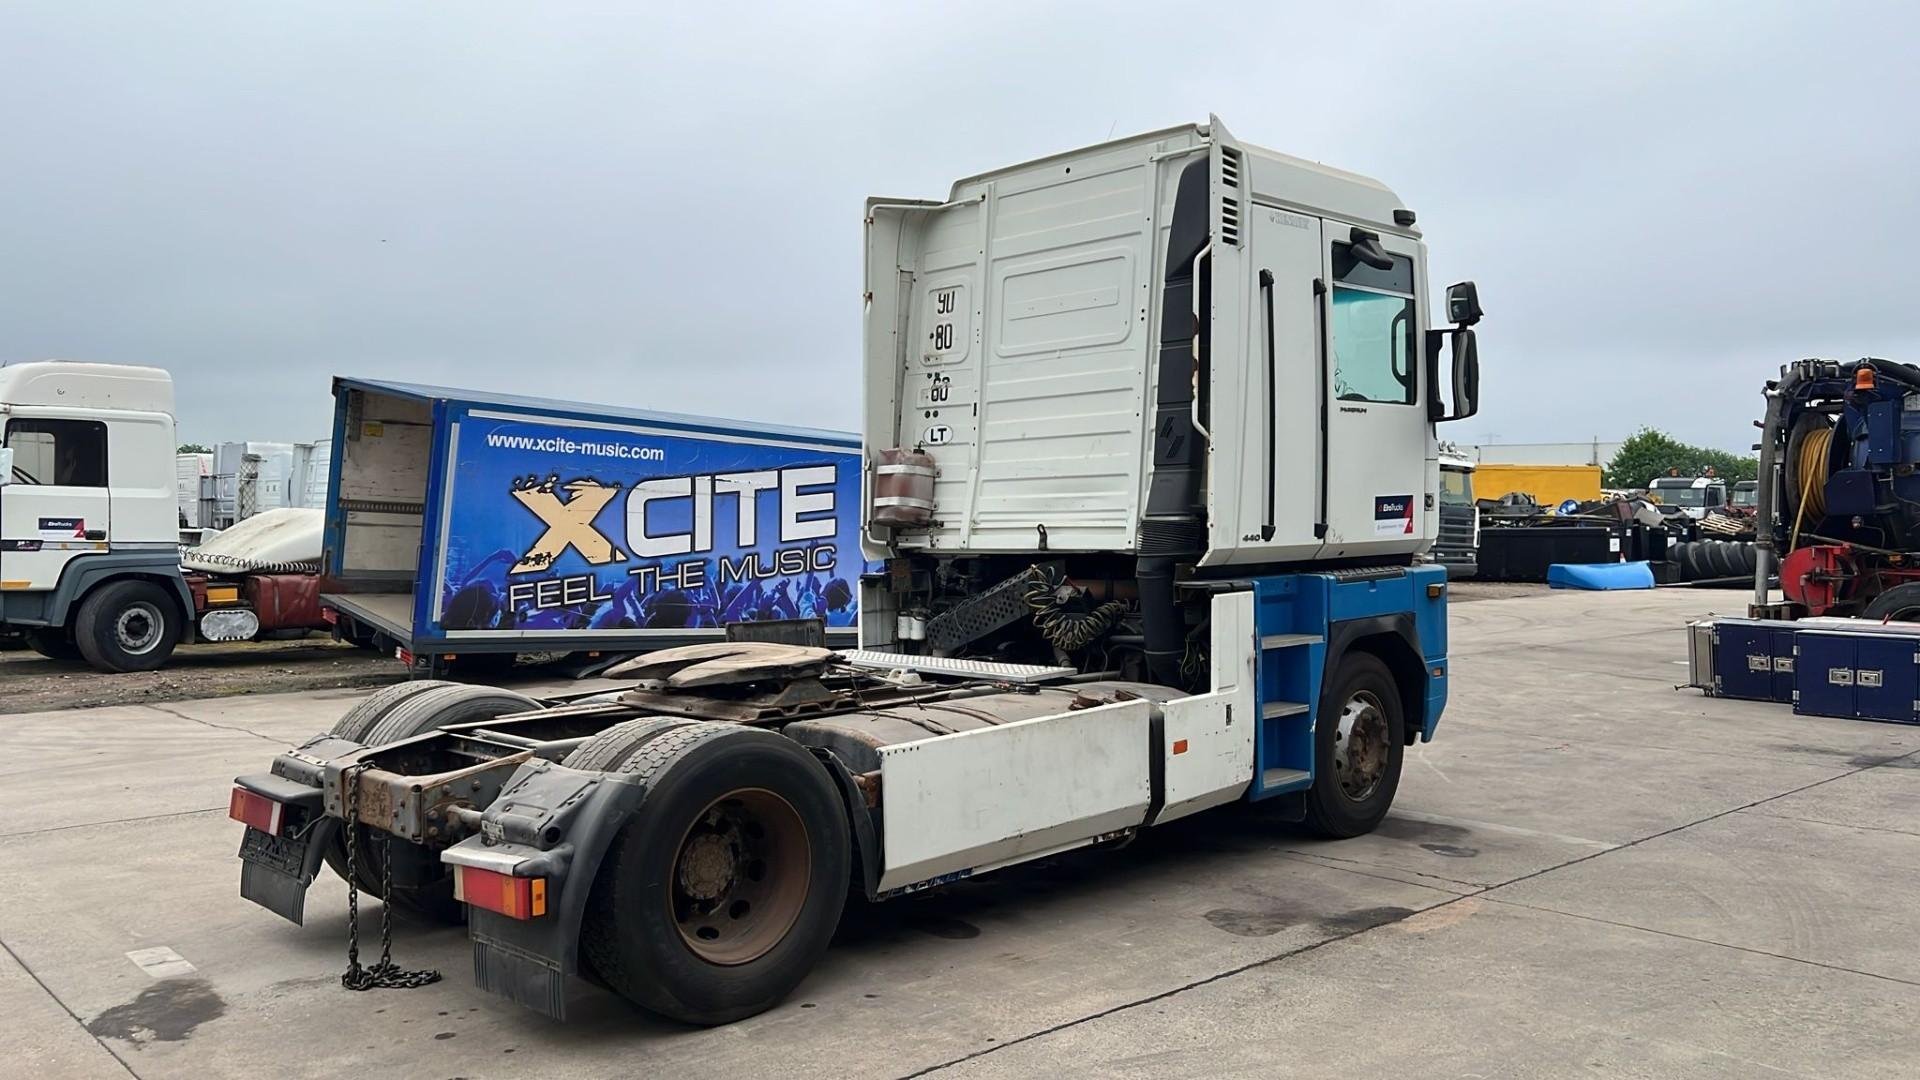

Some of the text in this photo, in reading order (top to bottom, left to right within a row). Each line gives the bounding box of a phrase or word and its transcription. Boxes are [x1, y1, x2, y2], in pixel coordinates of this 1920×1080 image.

[935, 323, 953, 350] 80
[487, 433, 664, 461] www.xcite-music.com
[930, 427, 948, 442] LT
[510, 465, 836, 574] XCITE
[1242, 534, 1260, 542] 440
[509, 545, 836, 613] FEEL THE MUSIC
